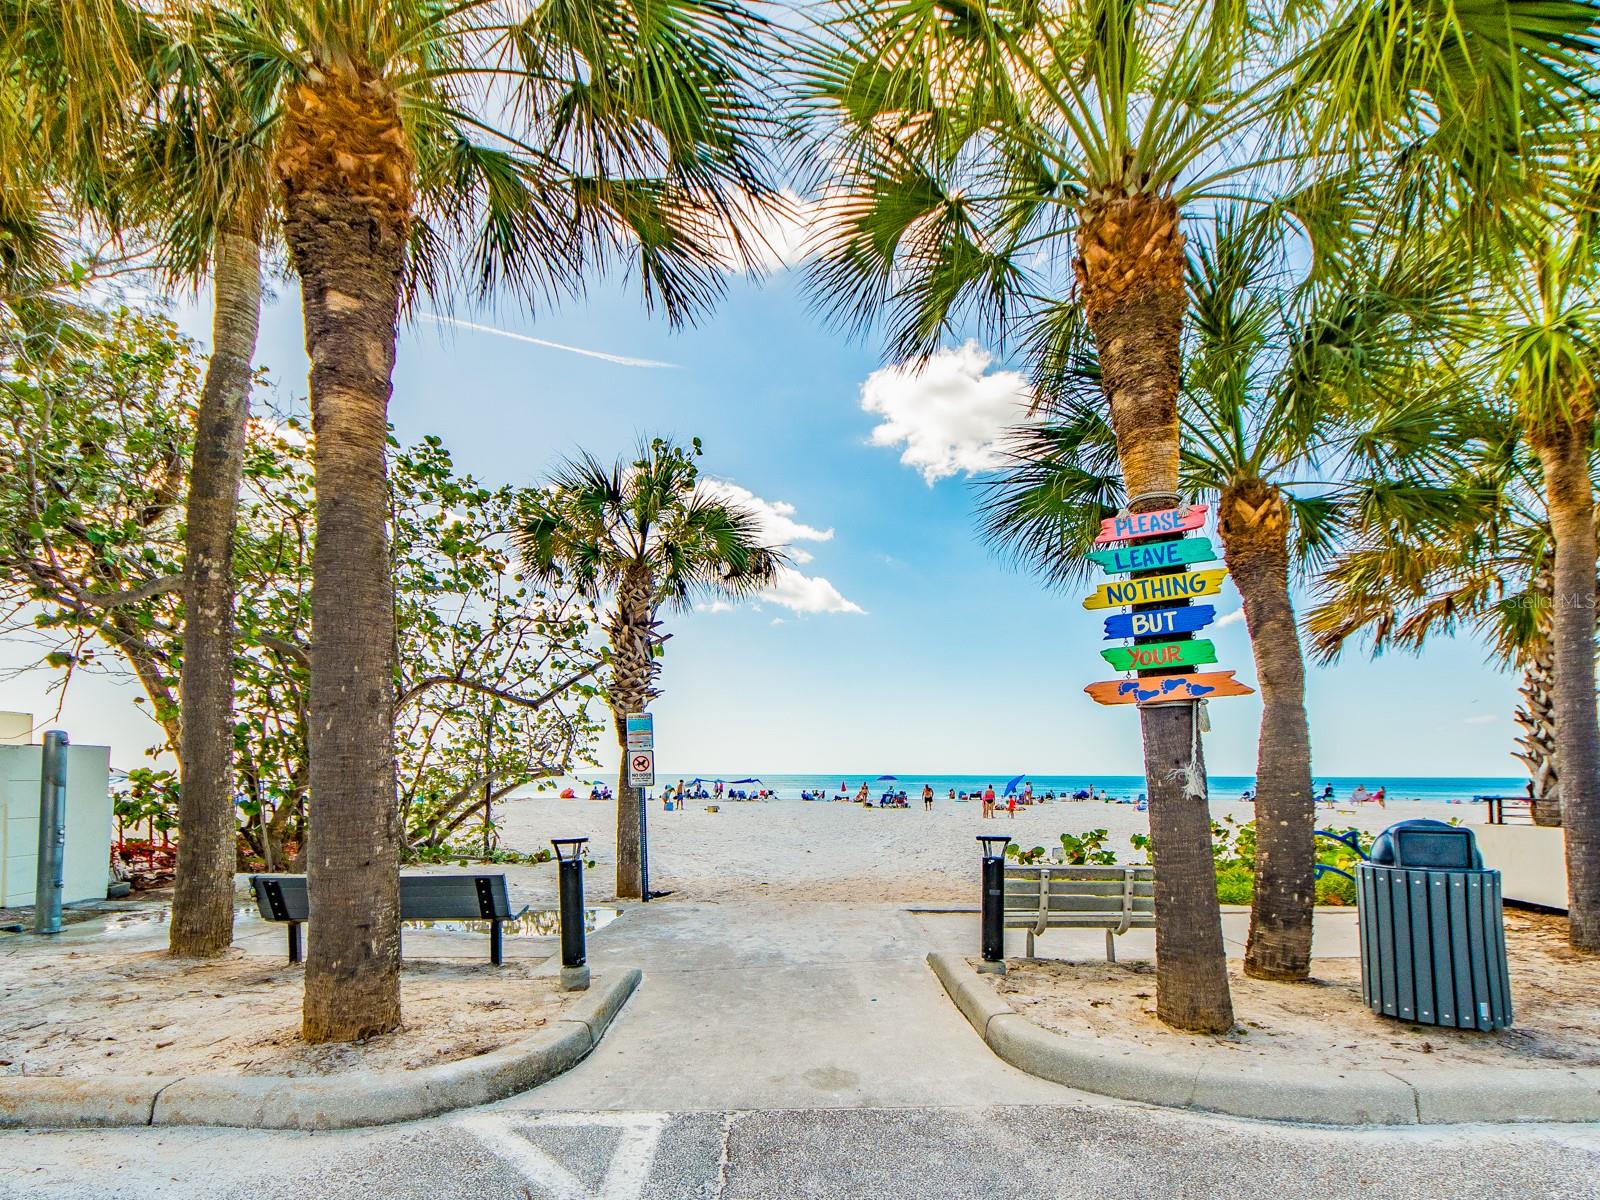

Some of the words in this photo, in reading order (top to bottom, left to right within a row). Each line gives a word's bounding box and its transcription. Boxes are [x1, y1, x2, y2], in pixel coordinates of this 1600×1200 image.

[1114, 510, 1185, 537] PLEASE
[1114, 543, 1183, 570] LEAVE
[1106, 573, 1206, 605] NOTHING
[1131, 610, 1178, 635] BUT
[1127, 645, 1184, 668] YOUR
